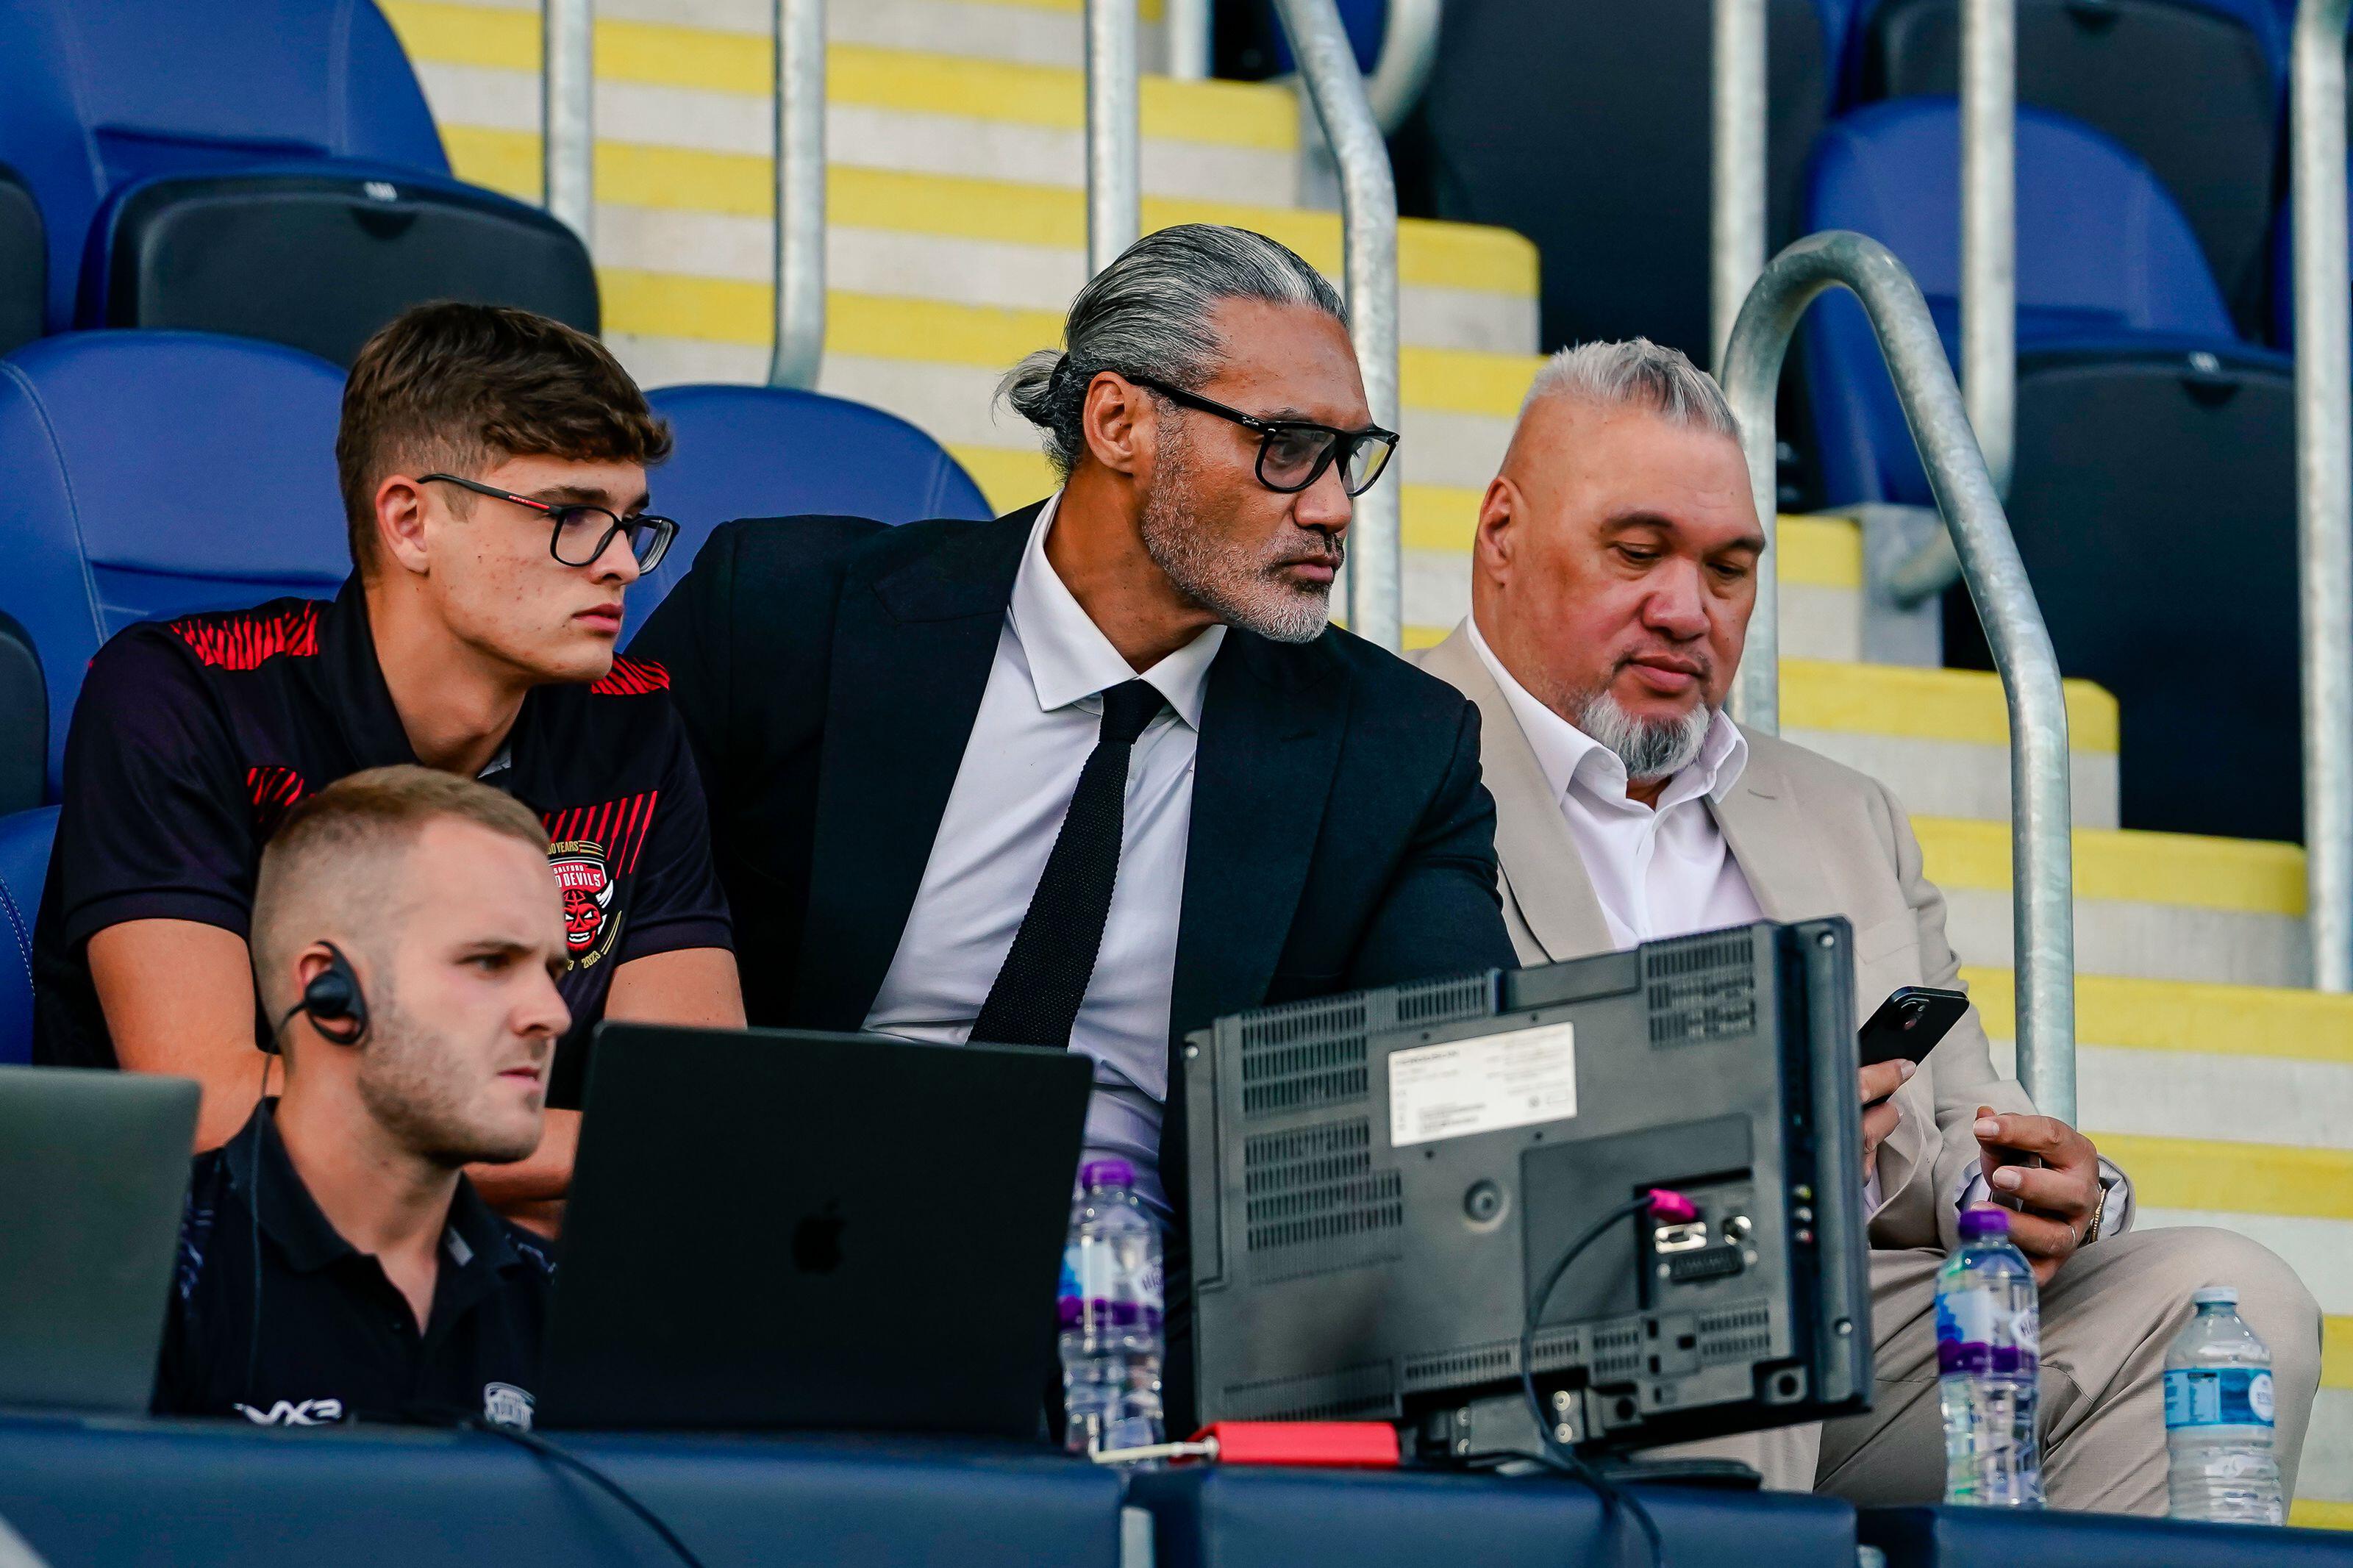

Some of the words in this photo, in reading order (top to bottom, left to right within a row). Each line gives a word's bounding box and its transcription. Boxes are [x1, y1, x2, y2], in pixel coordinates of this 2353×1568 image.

[556, 841, 579, 853] YEARS
[553, 864, 585, 874] SALFORD
[563, 872, 601, 887] DEVILS
[581, 950, 601, 969] 2023
